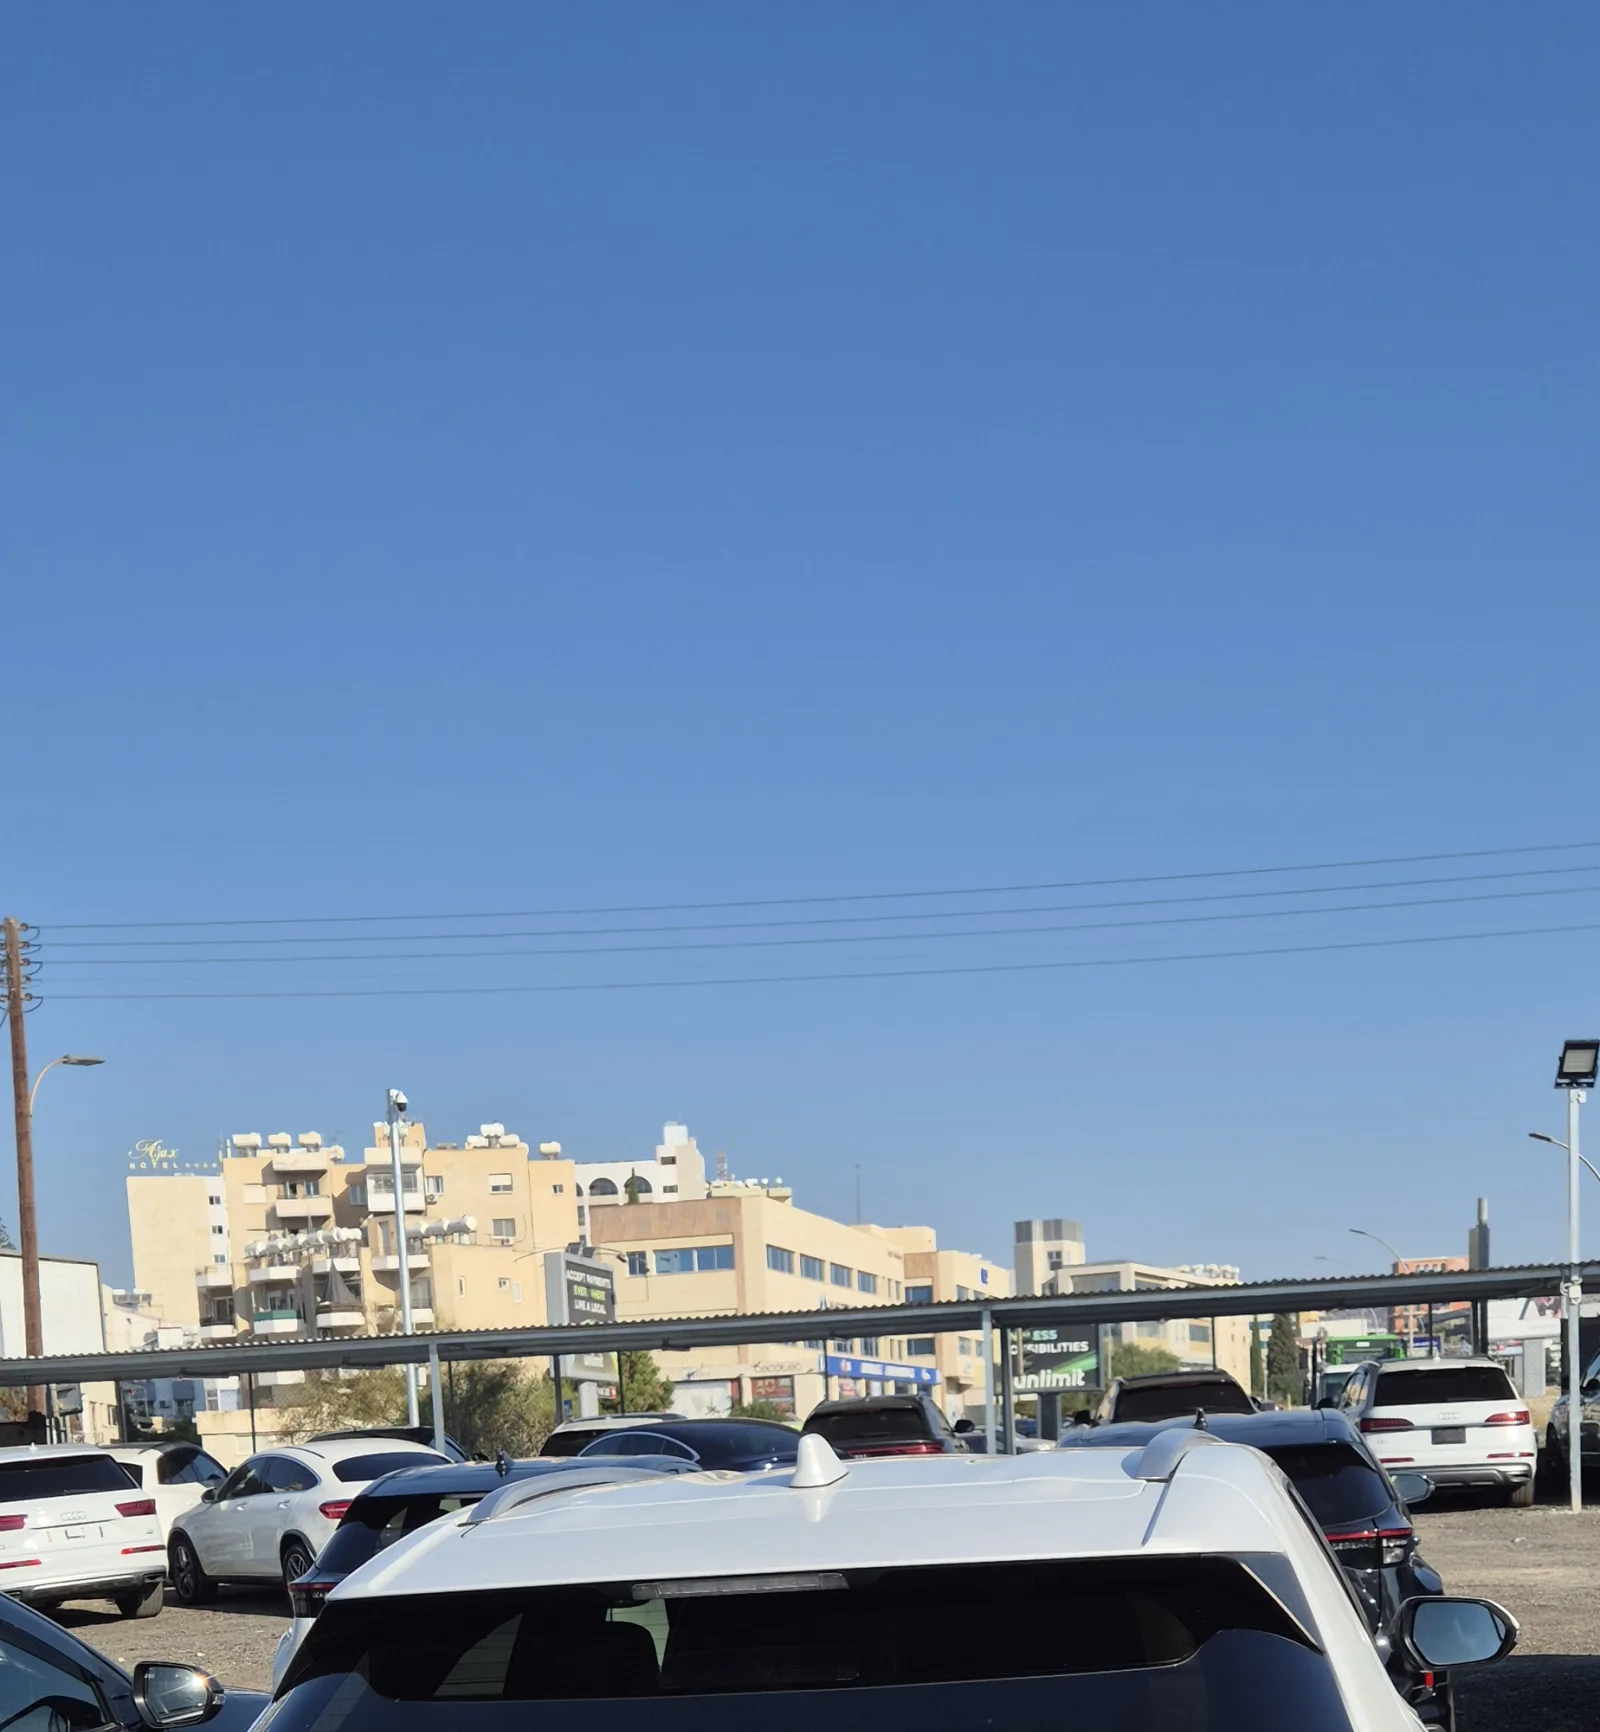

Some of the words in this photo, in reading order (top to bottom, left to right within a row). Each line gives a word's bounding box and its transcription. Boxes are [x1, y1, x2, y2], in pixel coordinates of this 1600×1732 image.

[128, 1139, 179, 1162] Ajax
[129, 1161, 178, 1170] HOTEL
[566, 1270, 586, 1283] ACCEPT
[586, 1274, 611, 1289] PAYMENTS
[574, 1299, 586, 1311] LIKE
[591, 1302, 607, 1315] LOCAL
[1013, 1368, 1086, 1389] unlimit
